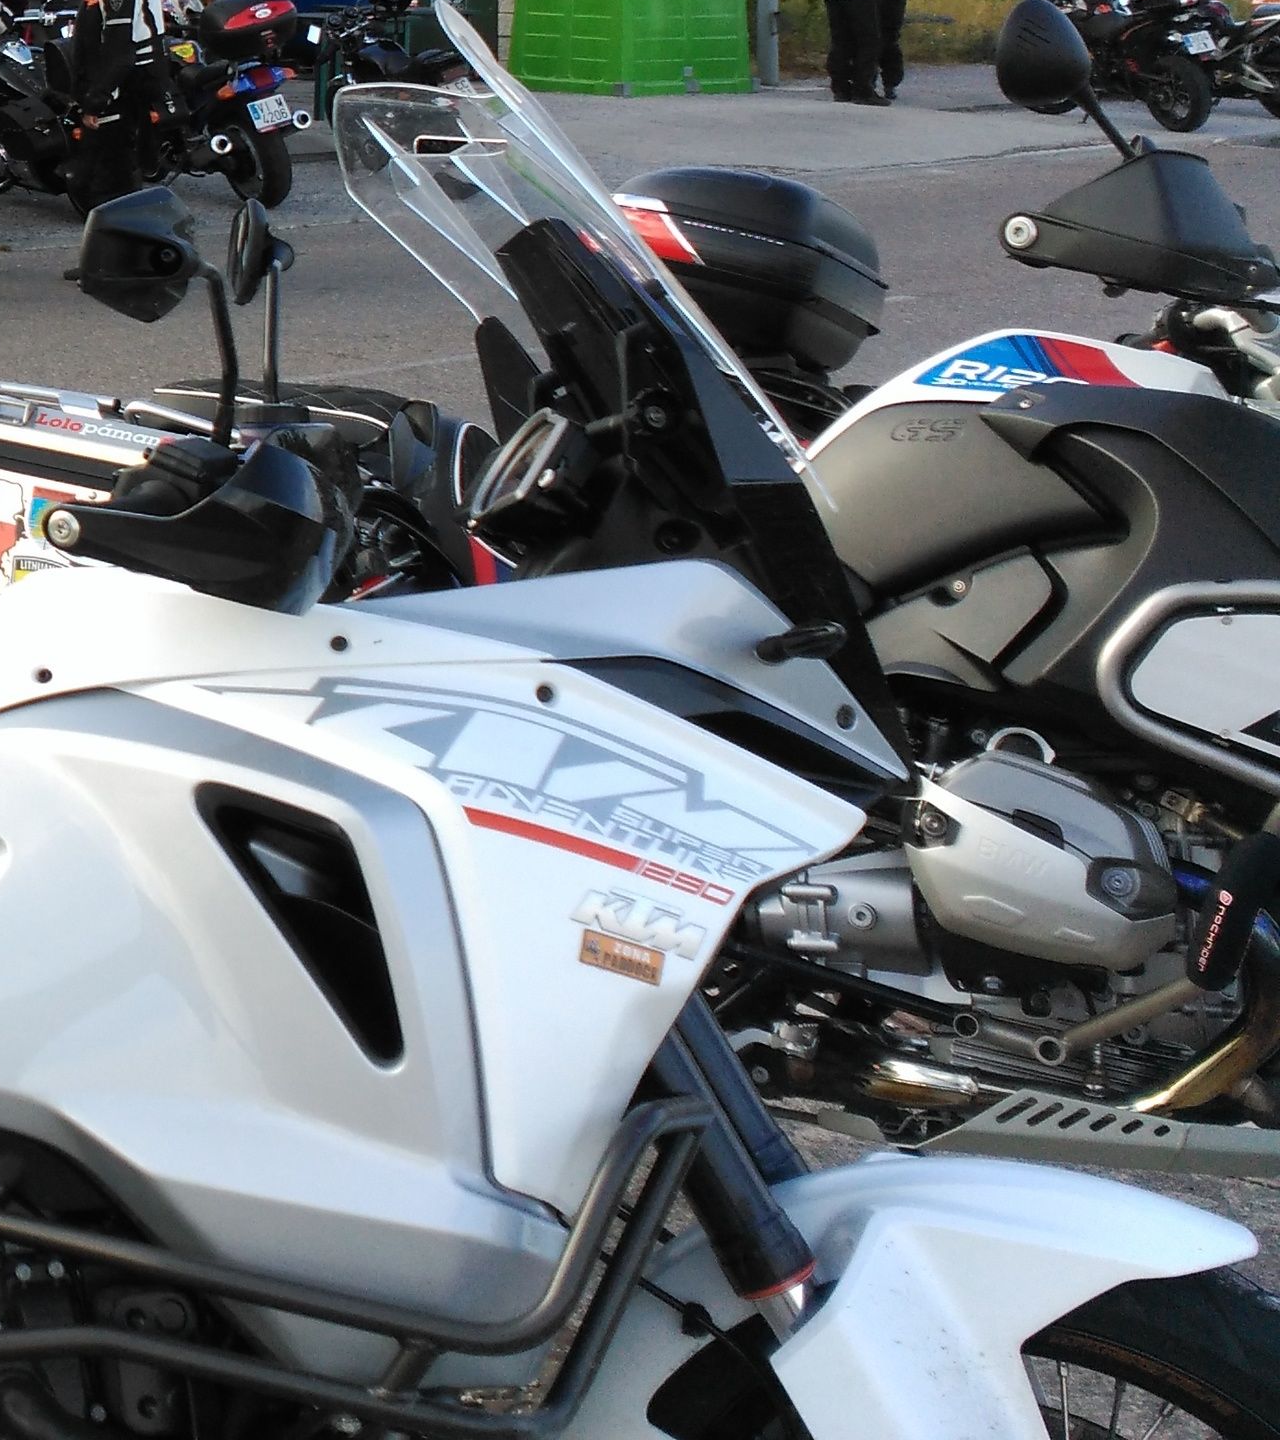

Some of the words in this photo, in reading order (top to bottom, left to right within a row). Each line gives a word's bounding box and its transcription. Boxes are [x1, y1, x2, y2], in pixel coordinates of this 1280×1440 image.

[263, 108, 288, 123] 4206
[890, 417, 968, 442] GS
[440, 774, 756, 883] ADVENTURE
[610, 802, 775, 875] SUPER
[633, 858, 736, 907] 1290
[569, 887, 708, 961] KTM
